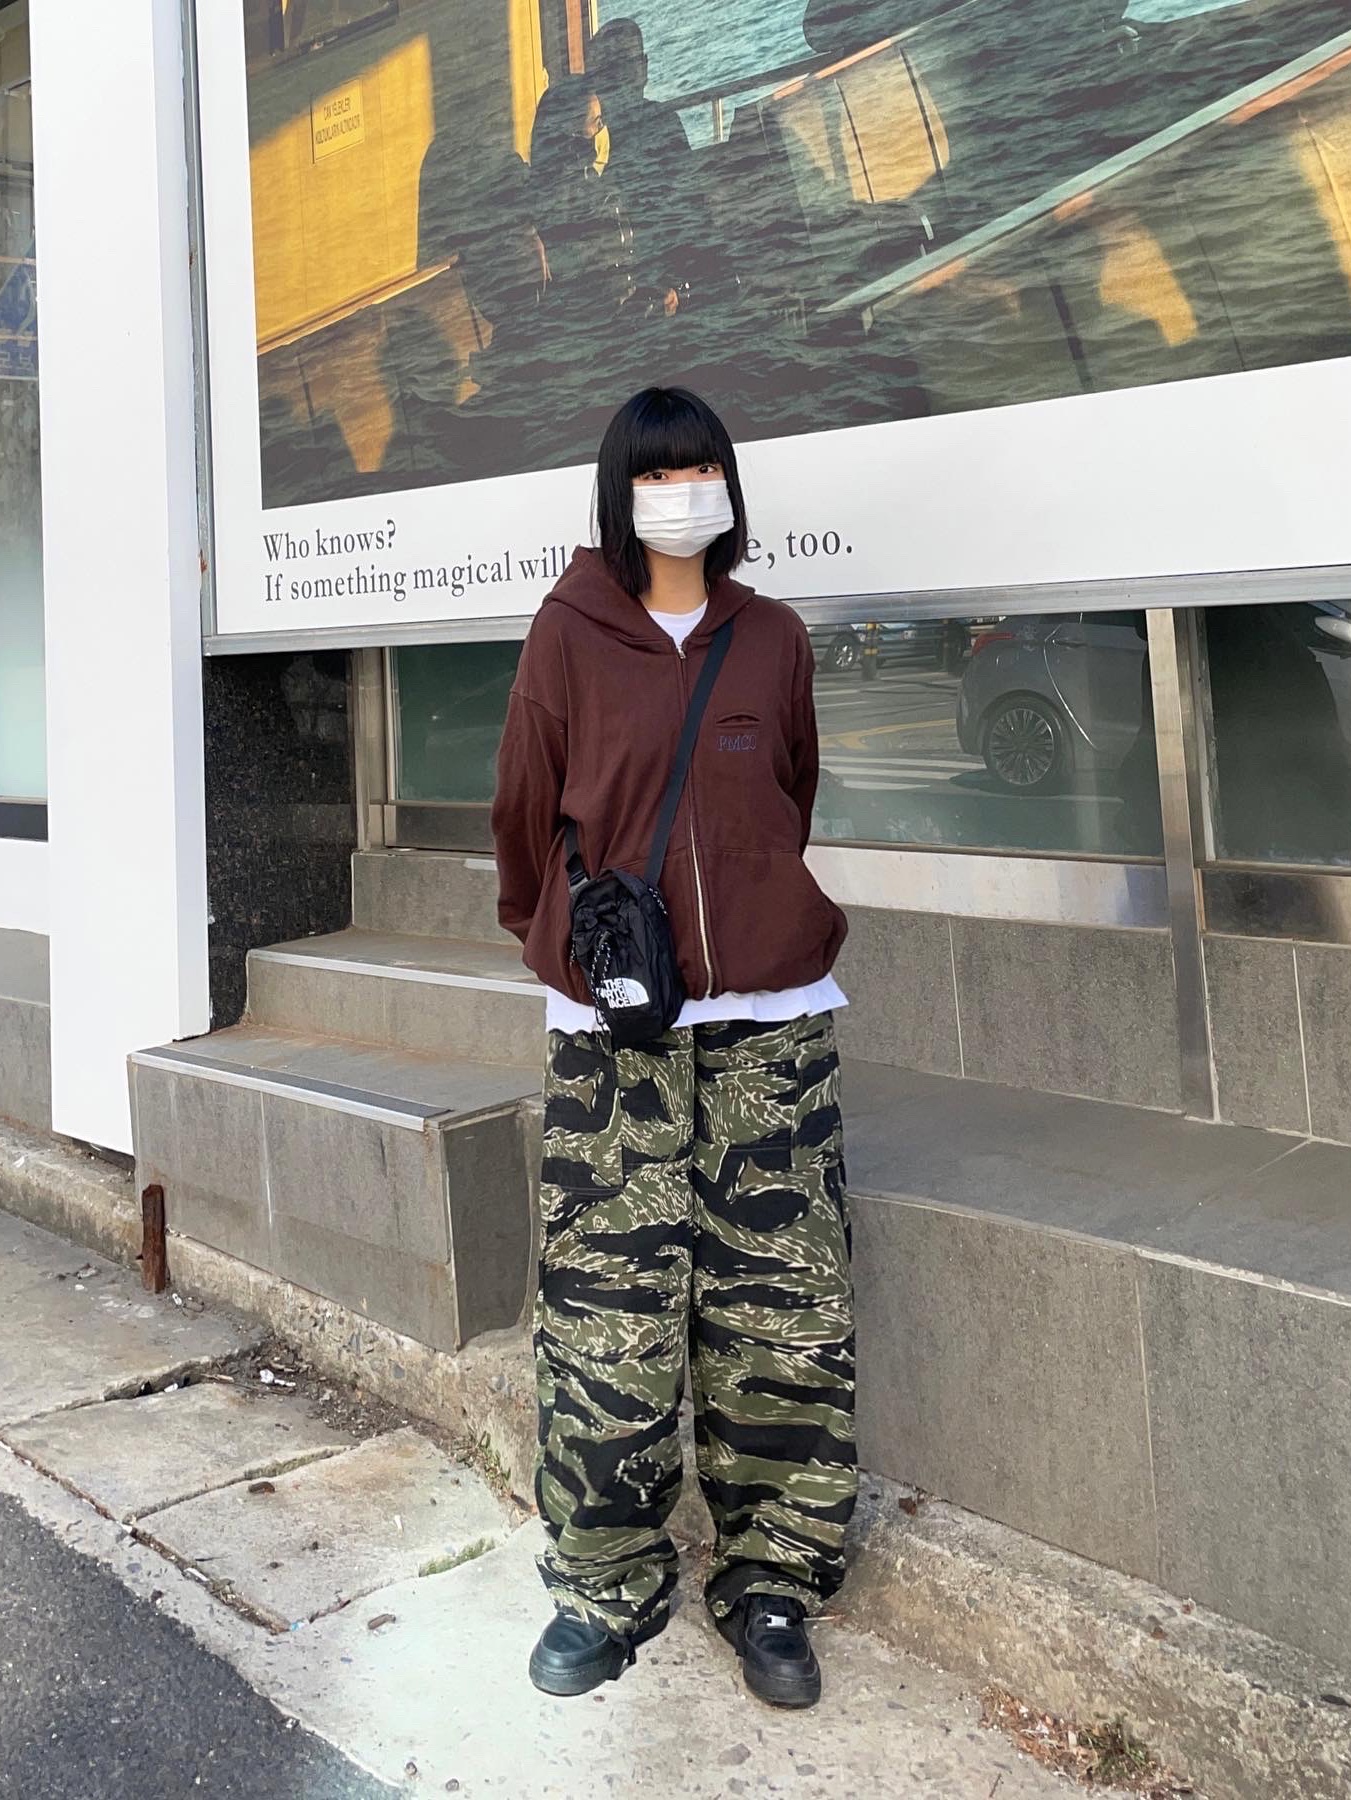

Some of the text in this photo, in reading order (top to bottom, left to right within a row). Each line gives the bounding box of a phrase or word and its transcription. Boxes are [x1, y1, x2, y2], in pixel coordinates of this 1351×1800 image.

[263, 519, 396, 562] Who knows?
[265, 530, 853, 602] If something magical will e, too.
[603, 977, 624, 991] THE
